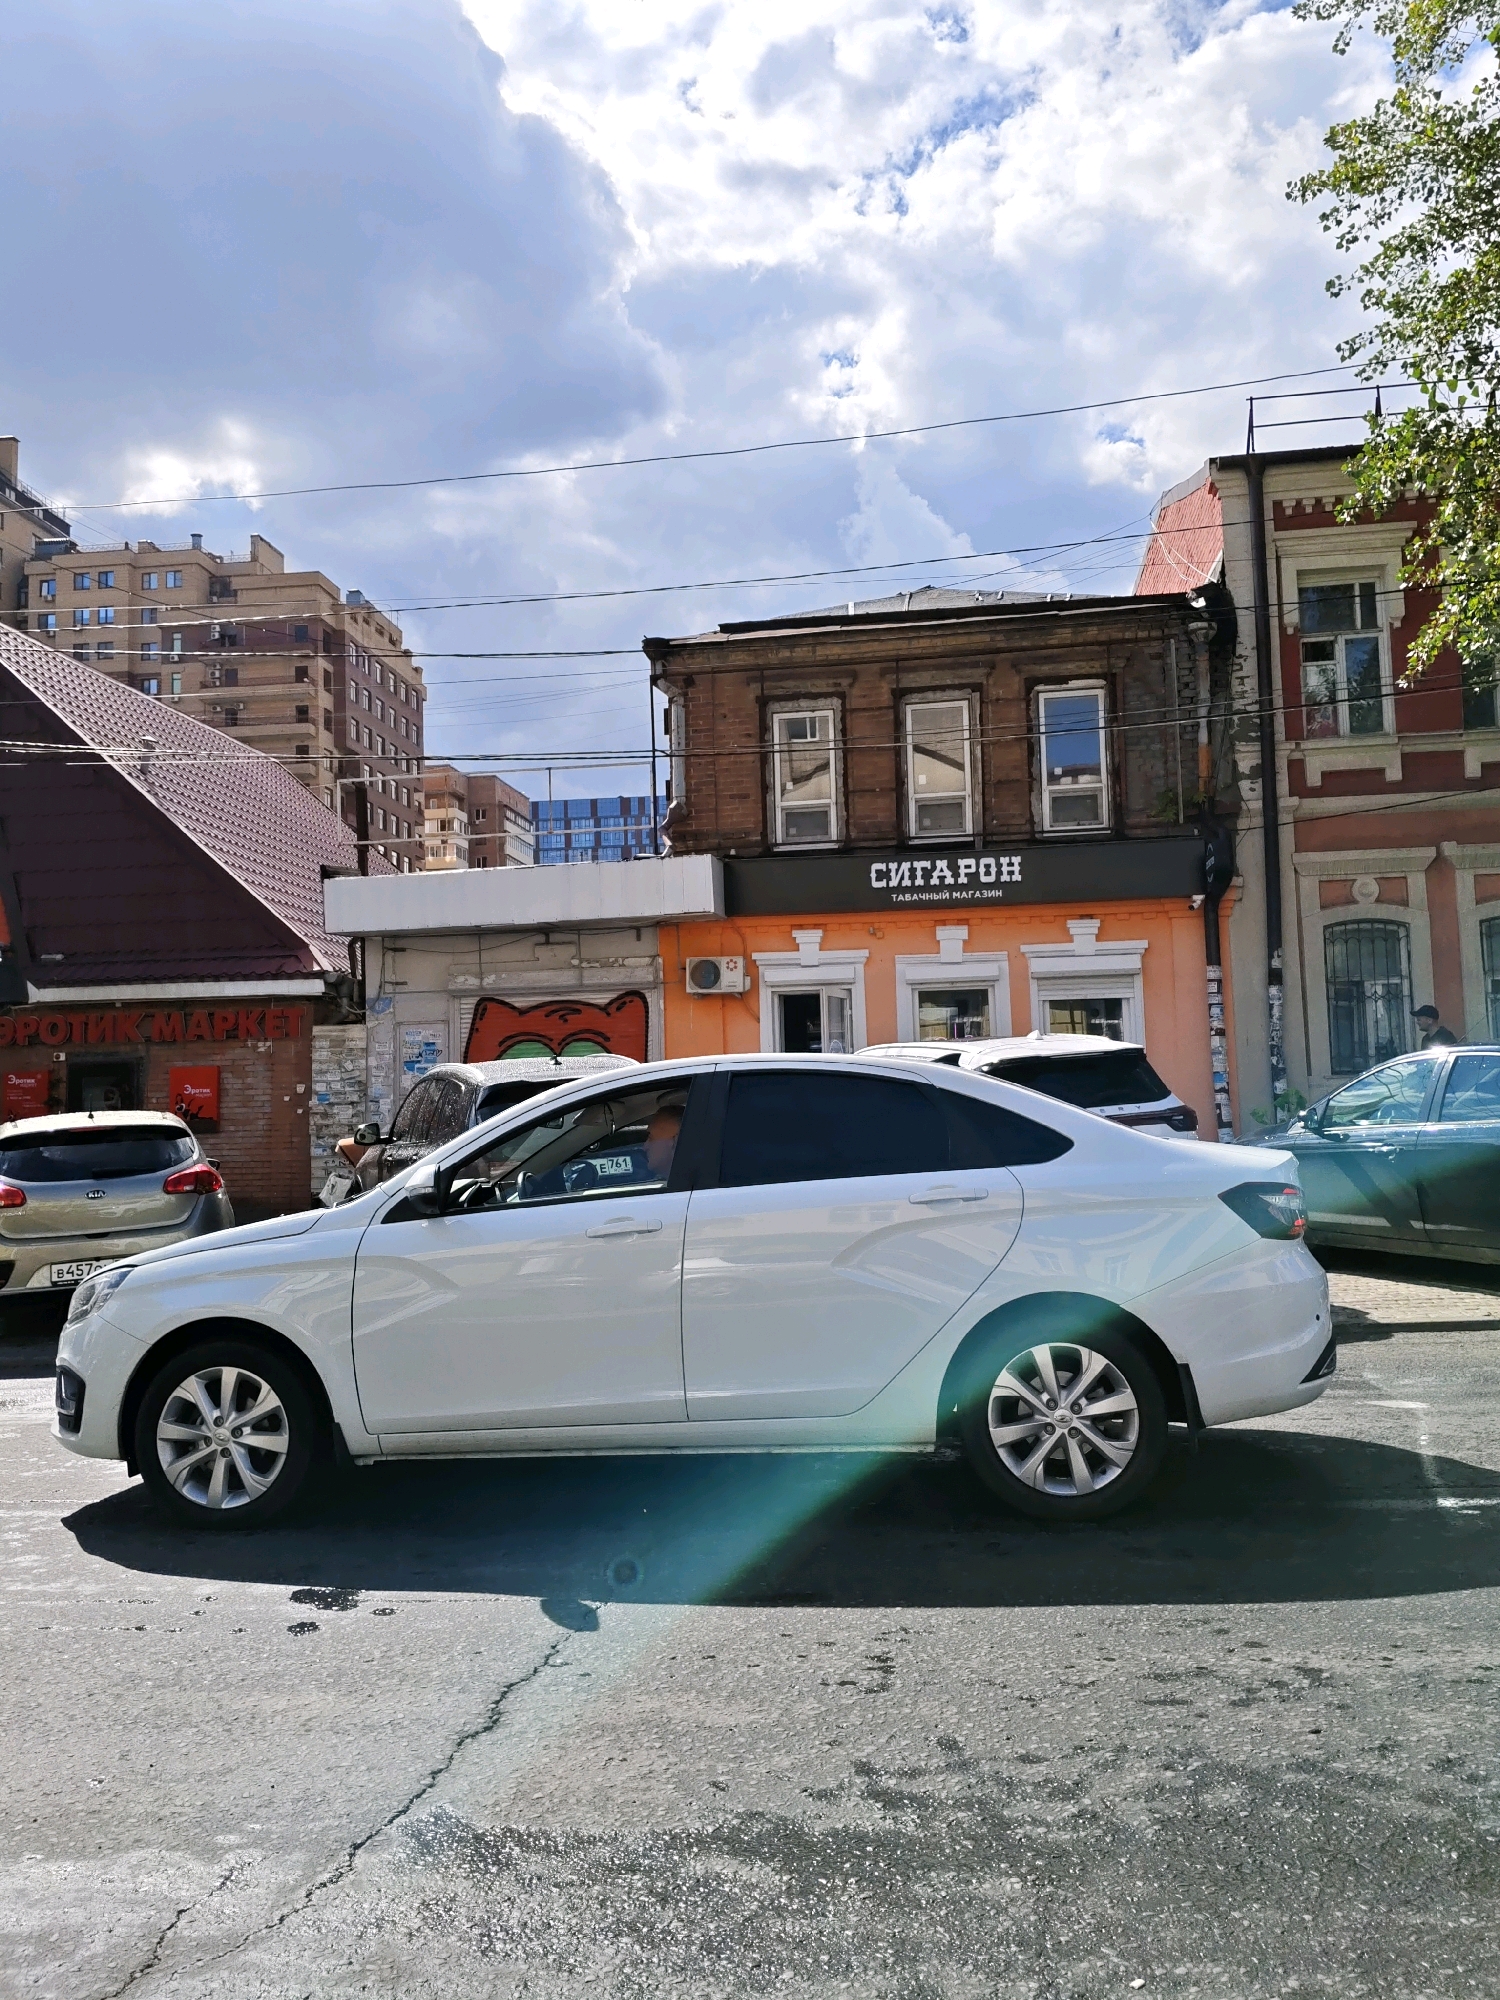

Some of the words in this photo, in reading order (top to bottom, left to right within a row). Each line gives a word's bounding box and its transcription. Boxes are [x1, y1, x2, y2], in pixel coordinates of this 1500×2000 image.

[870, 856, 1022, 888] СИГАРОН
[891, 890, 950, 902] ТАБАЧНЫЙ
[952, 889, 1003, 900] МАГАЗИН
[0, 1012, 145, 1046] ЭРОТИК
[151, 1007, 306, 1042] МАРКЕТ
[1099, 1105, 1141, 1114] ERY
[608, 1157, 628, 1169] 761
[88, 1190, 104, 1198] KIA
[56, 1262, 107, 1279] В457
